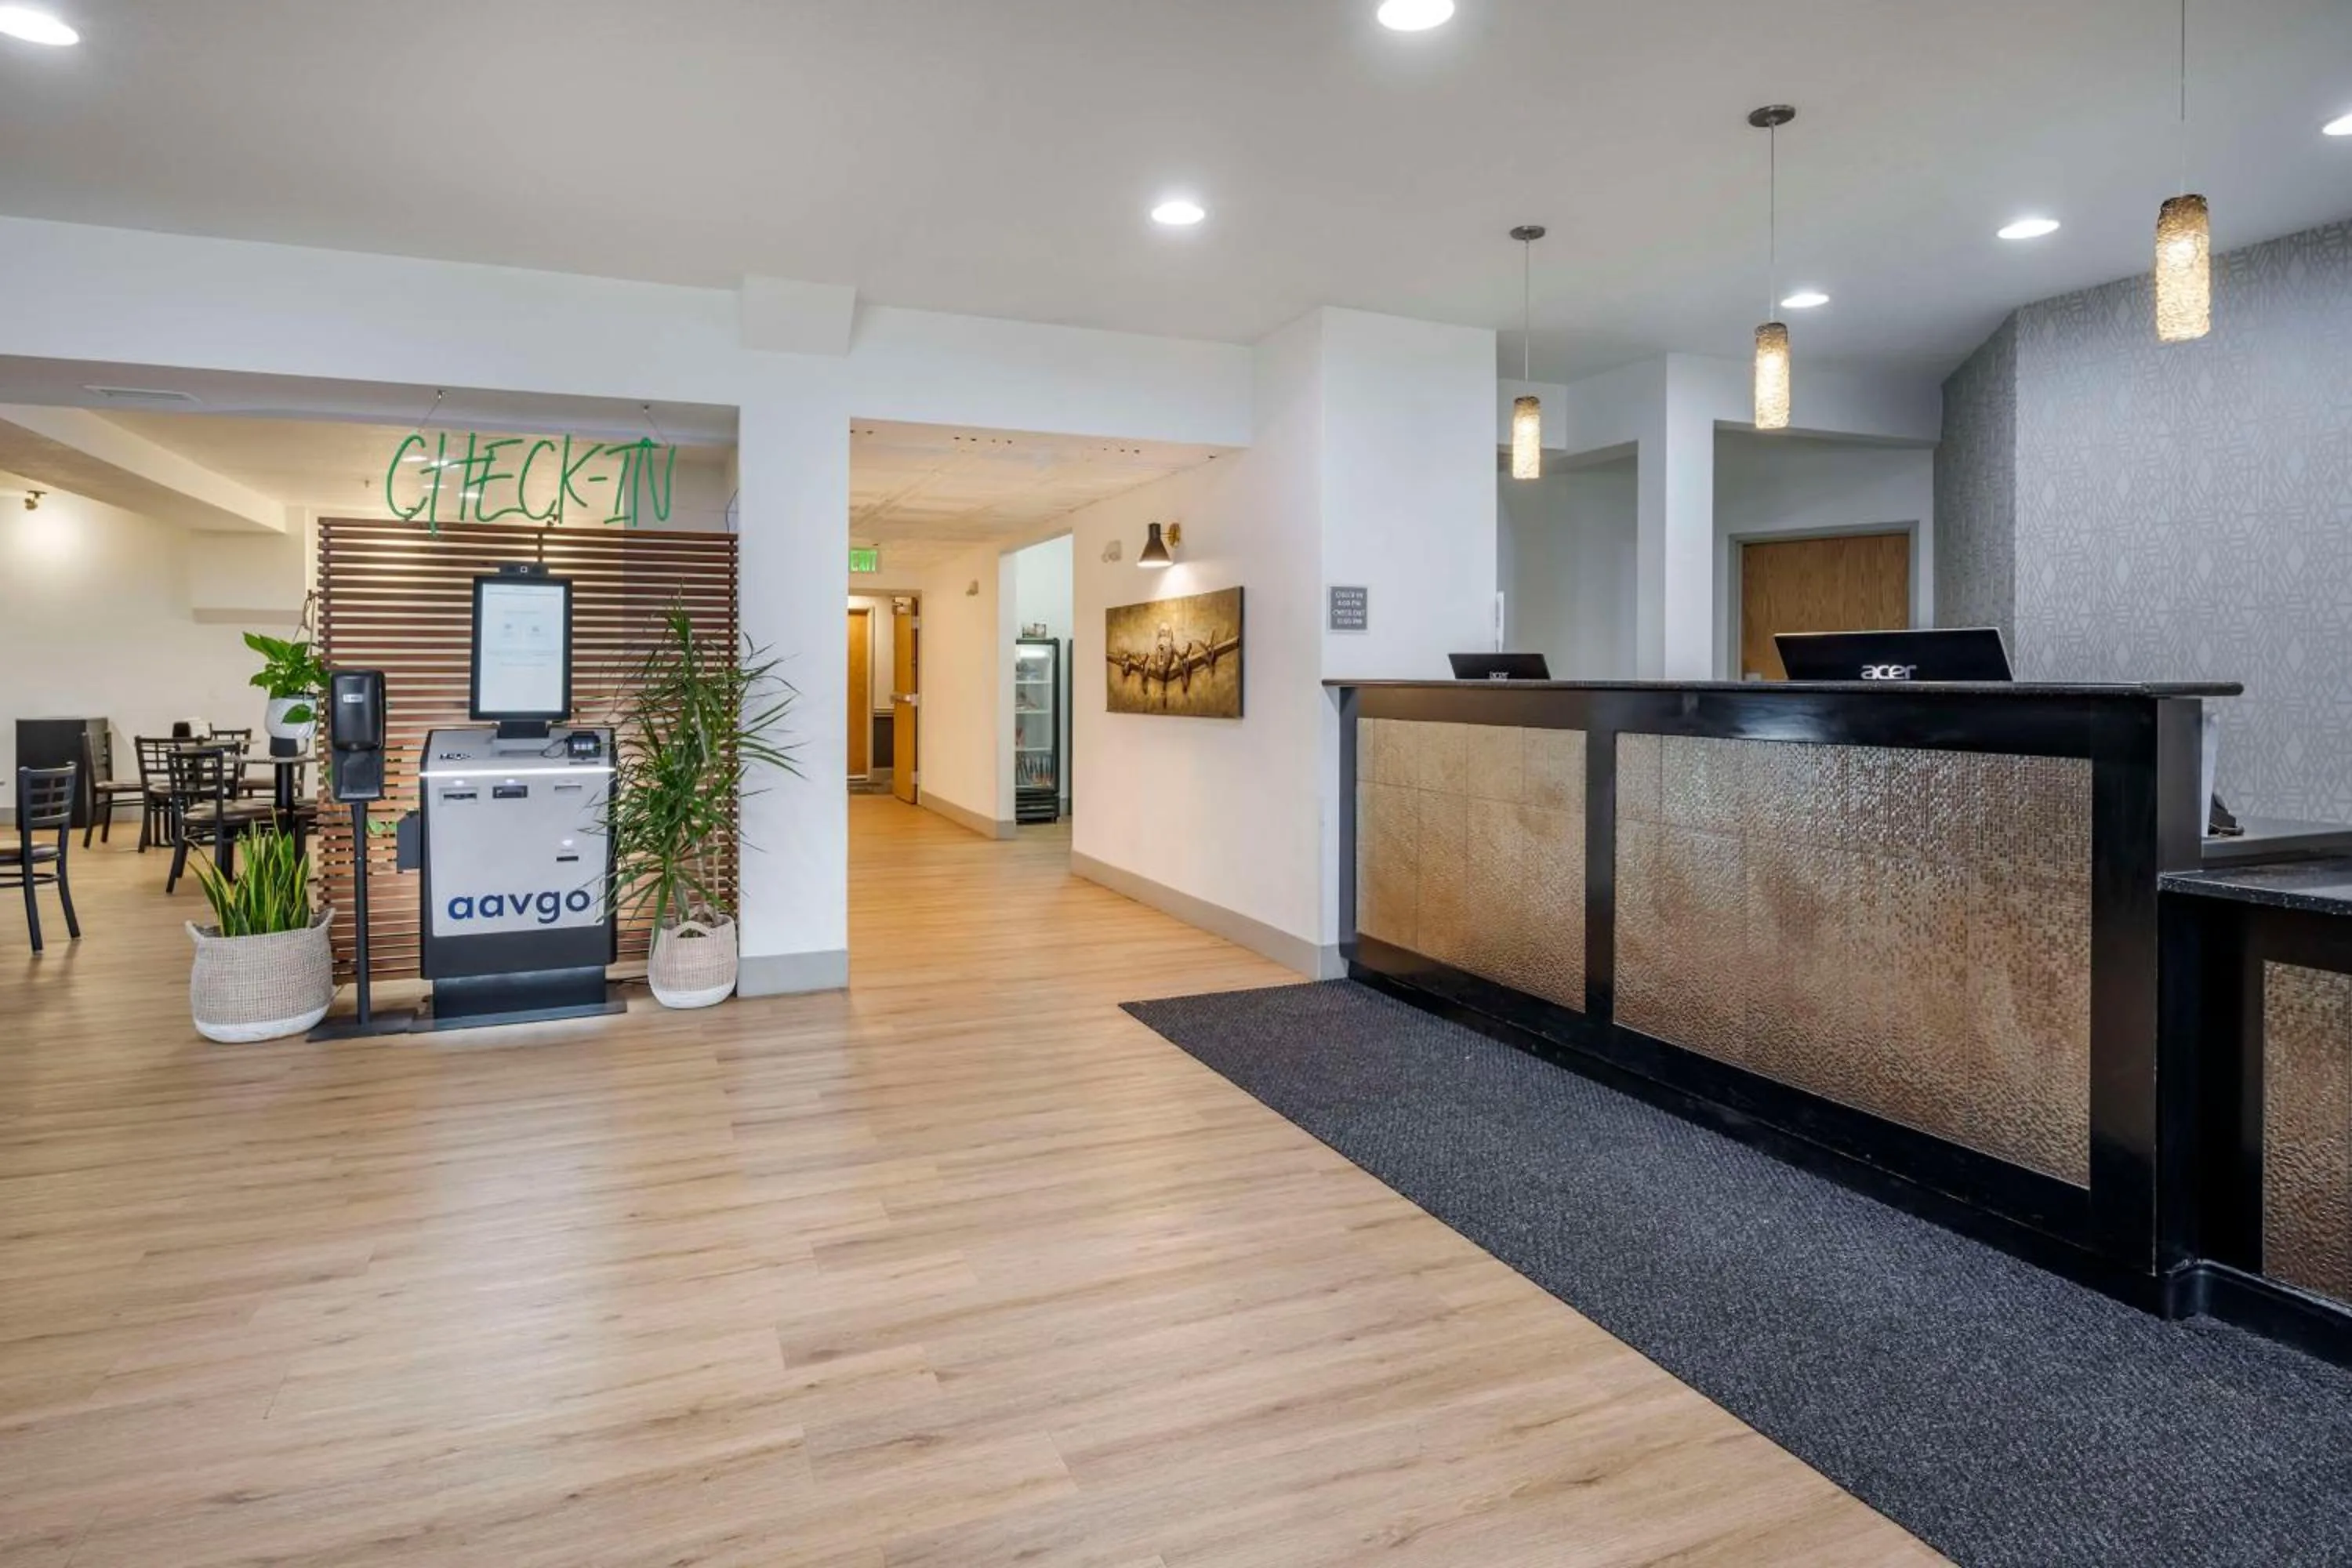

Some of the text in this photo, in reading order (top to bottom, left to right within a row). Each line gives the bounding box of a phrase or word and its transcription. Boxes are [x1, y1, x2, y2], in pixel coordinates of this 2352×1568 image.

[387, 433, 676, 536] CHECK-IN
[851, 550, 877, 572] EXIT
[1860, 665, 1916, 680] acer
[448, 890, 590, 924] aavgo
